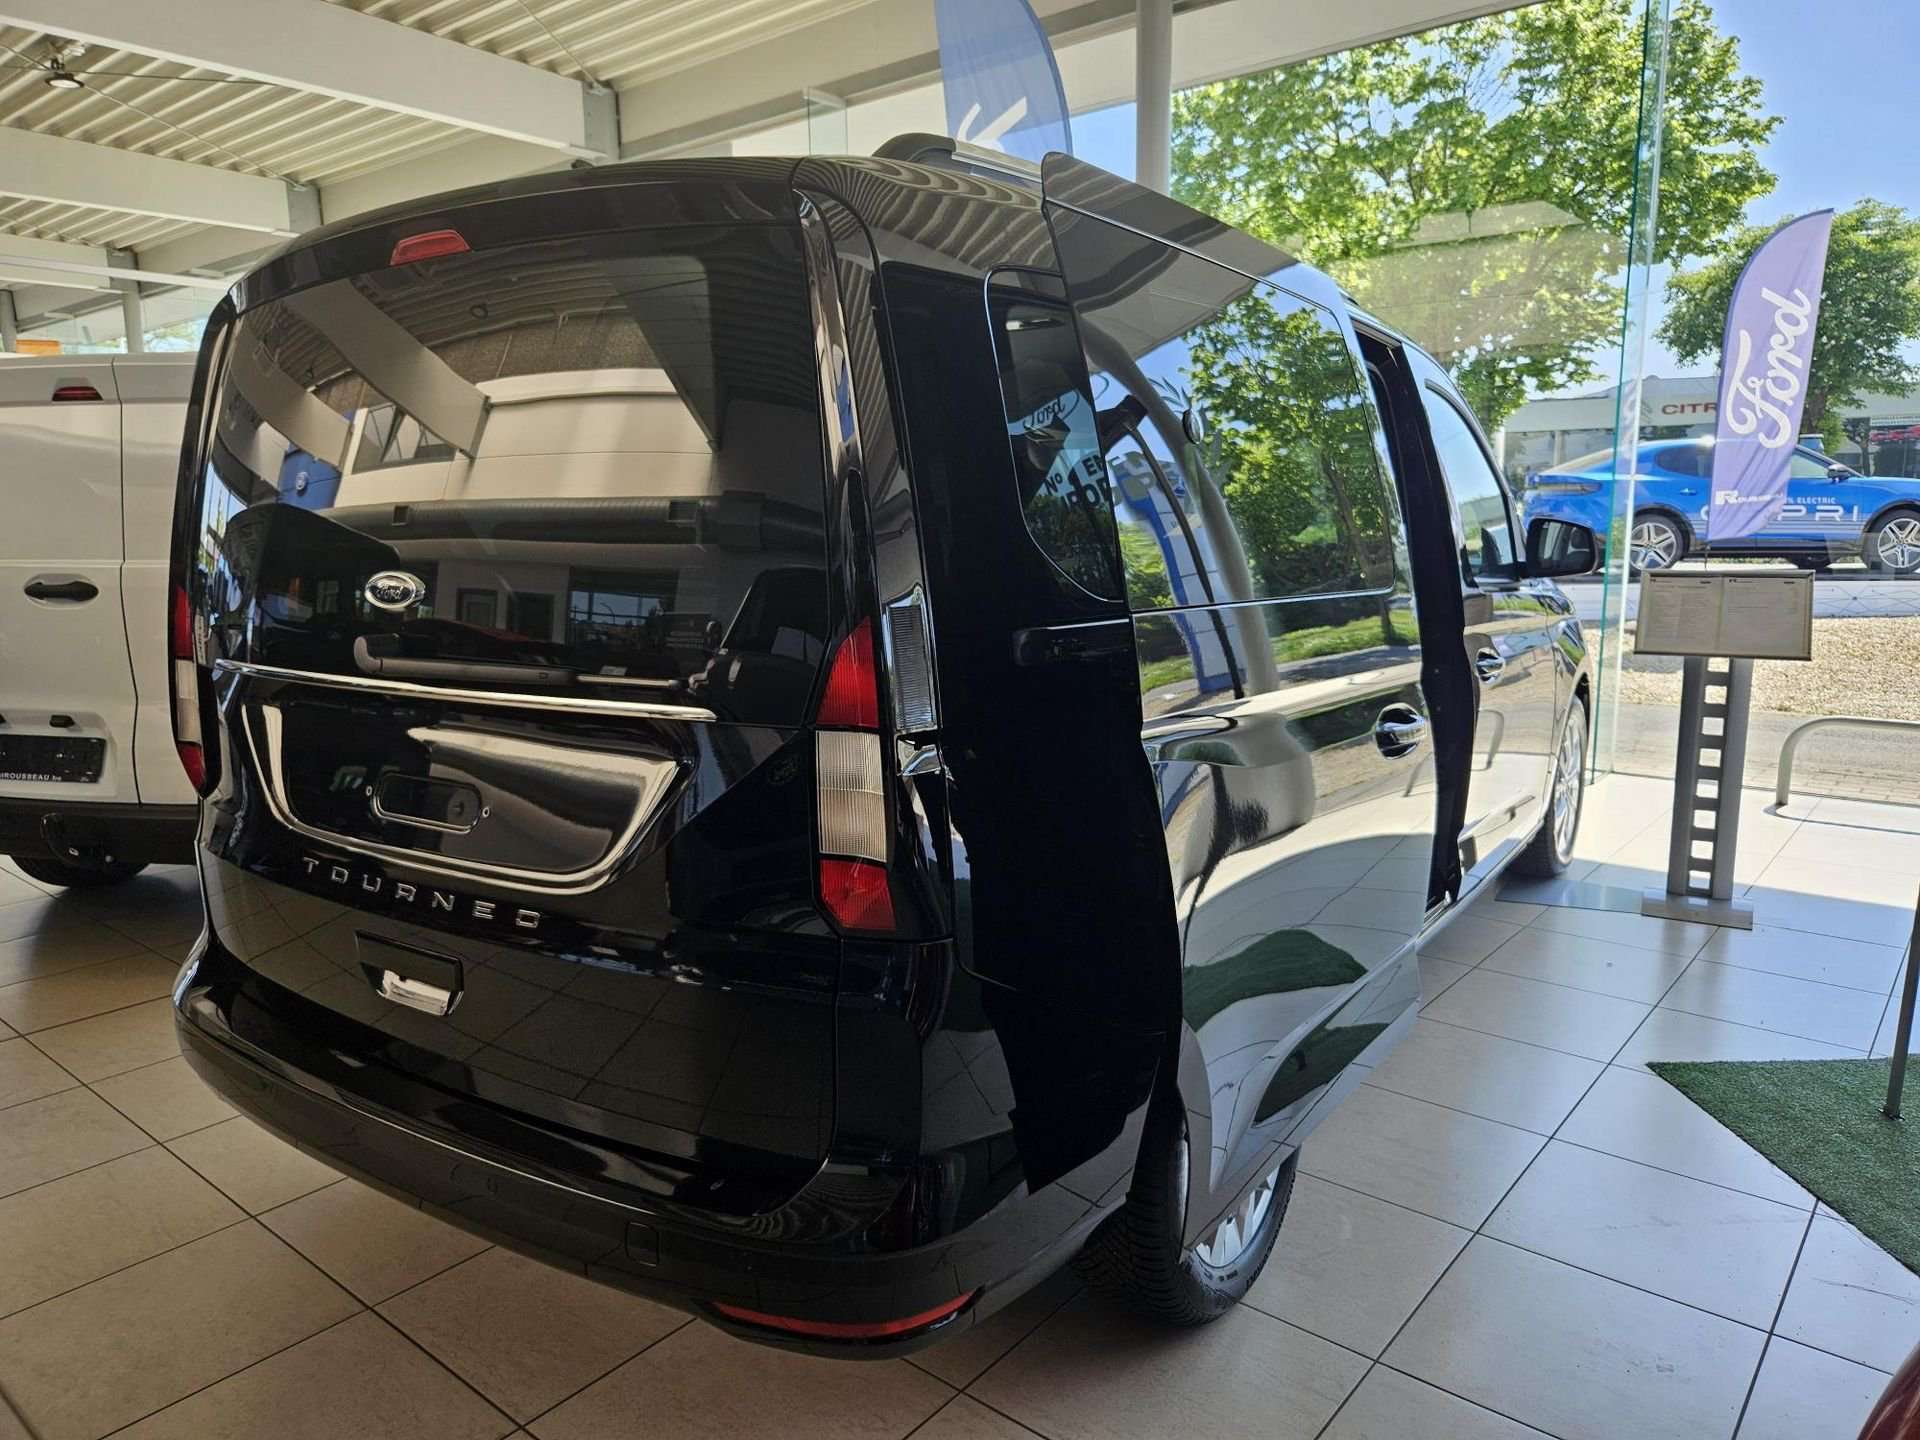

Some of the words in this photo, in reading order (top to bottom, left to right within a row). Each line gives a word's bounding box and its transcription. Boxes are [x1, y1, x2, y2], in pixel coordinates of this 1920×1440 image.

[1725, 287, 1812, 449] Ford
[1797, 496, 1836, 504] ELECTRIC
[303, 857, 541, 928] TOURNEO
